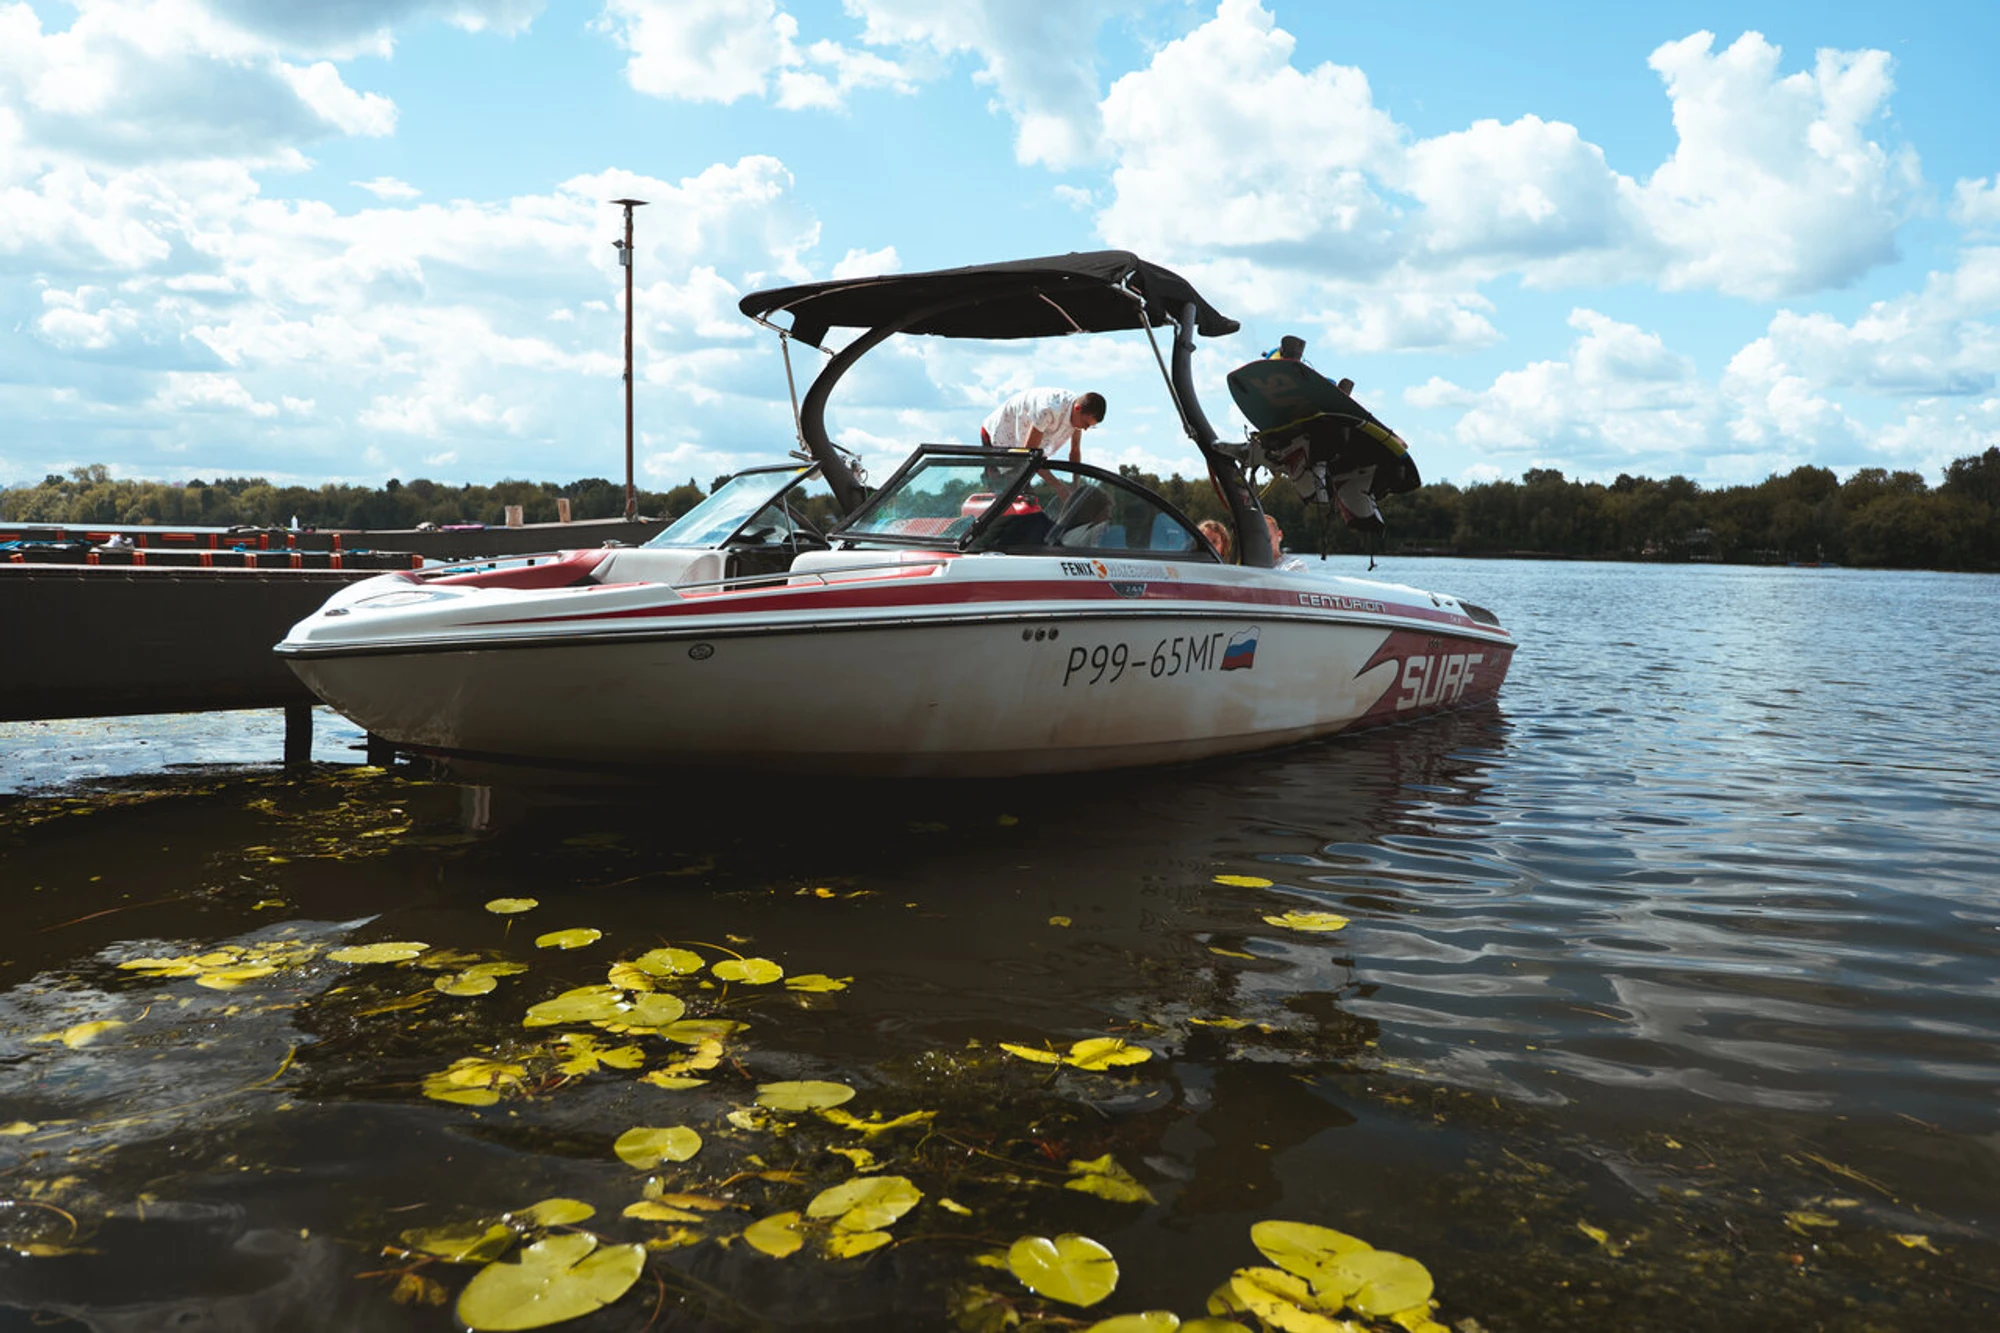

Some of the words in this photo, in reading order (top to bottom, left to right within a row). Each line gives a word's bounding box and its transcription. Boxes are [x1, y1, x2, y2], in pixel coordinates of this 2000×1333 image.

[1060, 562, 1095, 577] FENIX
[1297, 593, 1387, 613] CENTURION
[1063, 632, 1224, 687] Р99-65МГ
[1396, 653, 1484, 711] SURF
